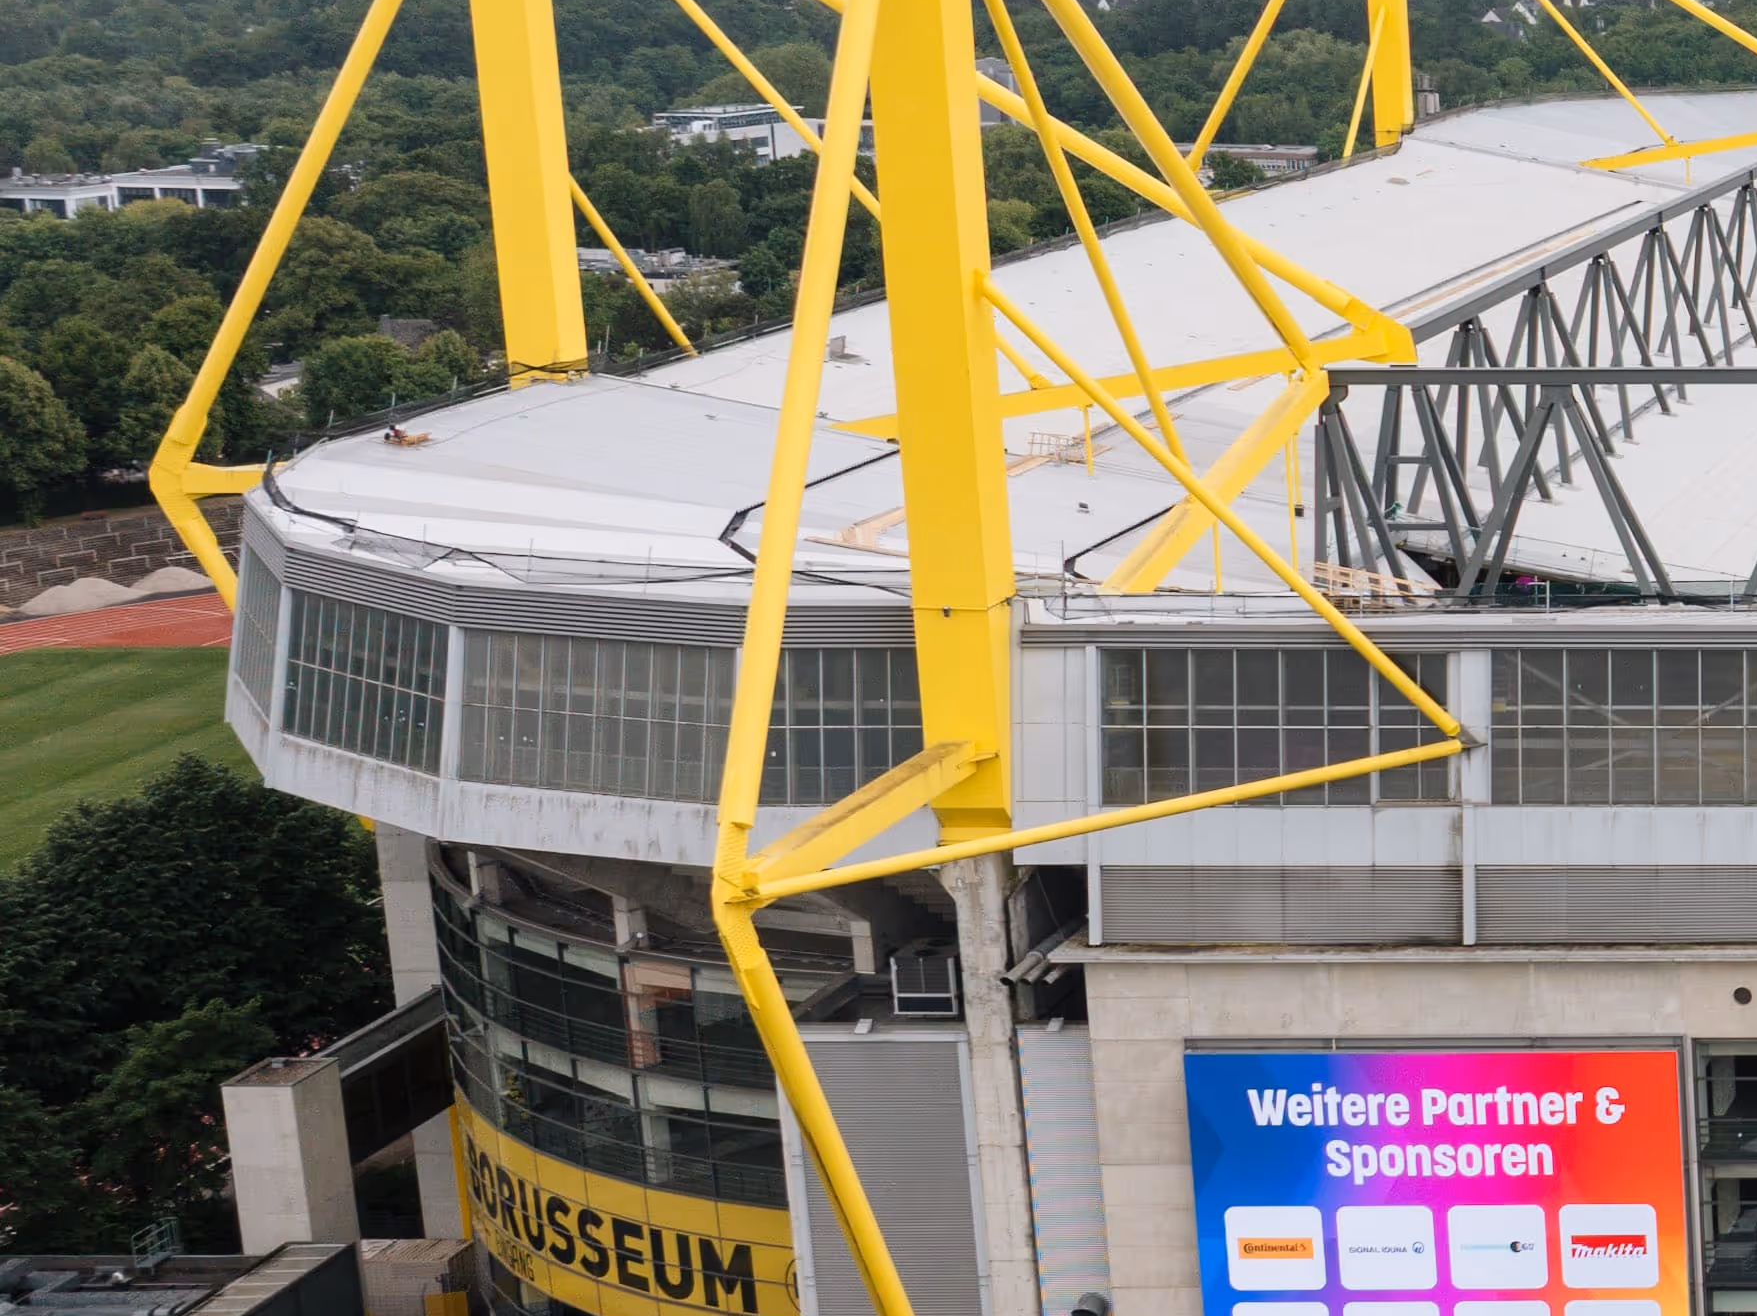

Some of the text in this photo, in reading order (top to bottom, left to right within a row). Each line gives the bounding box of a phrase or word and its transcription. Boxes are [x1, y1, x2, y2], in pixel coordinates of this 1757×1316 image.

[1247, 1083, 1625, 1126] Weitere Partner &
[1326, 1140, 1553, 1185] Sponsoren
[466, 1133, 758, 1314] BORUSSEUM
[1243, 1242, 1298, 1254] Continental
[1571, 1243, 1648, 1259] makita
